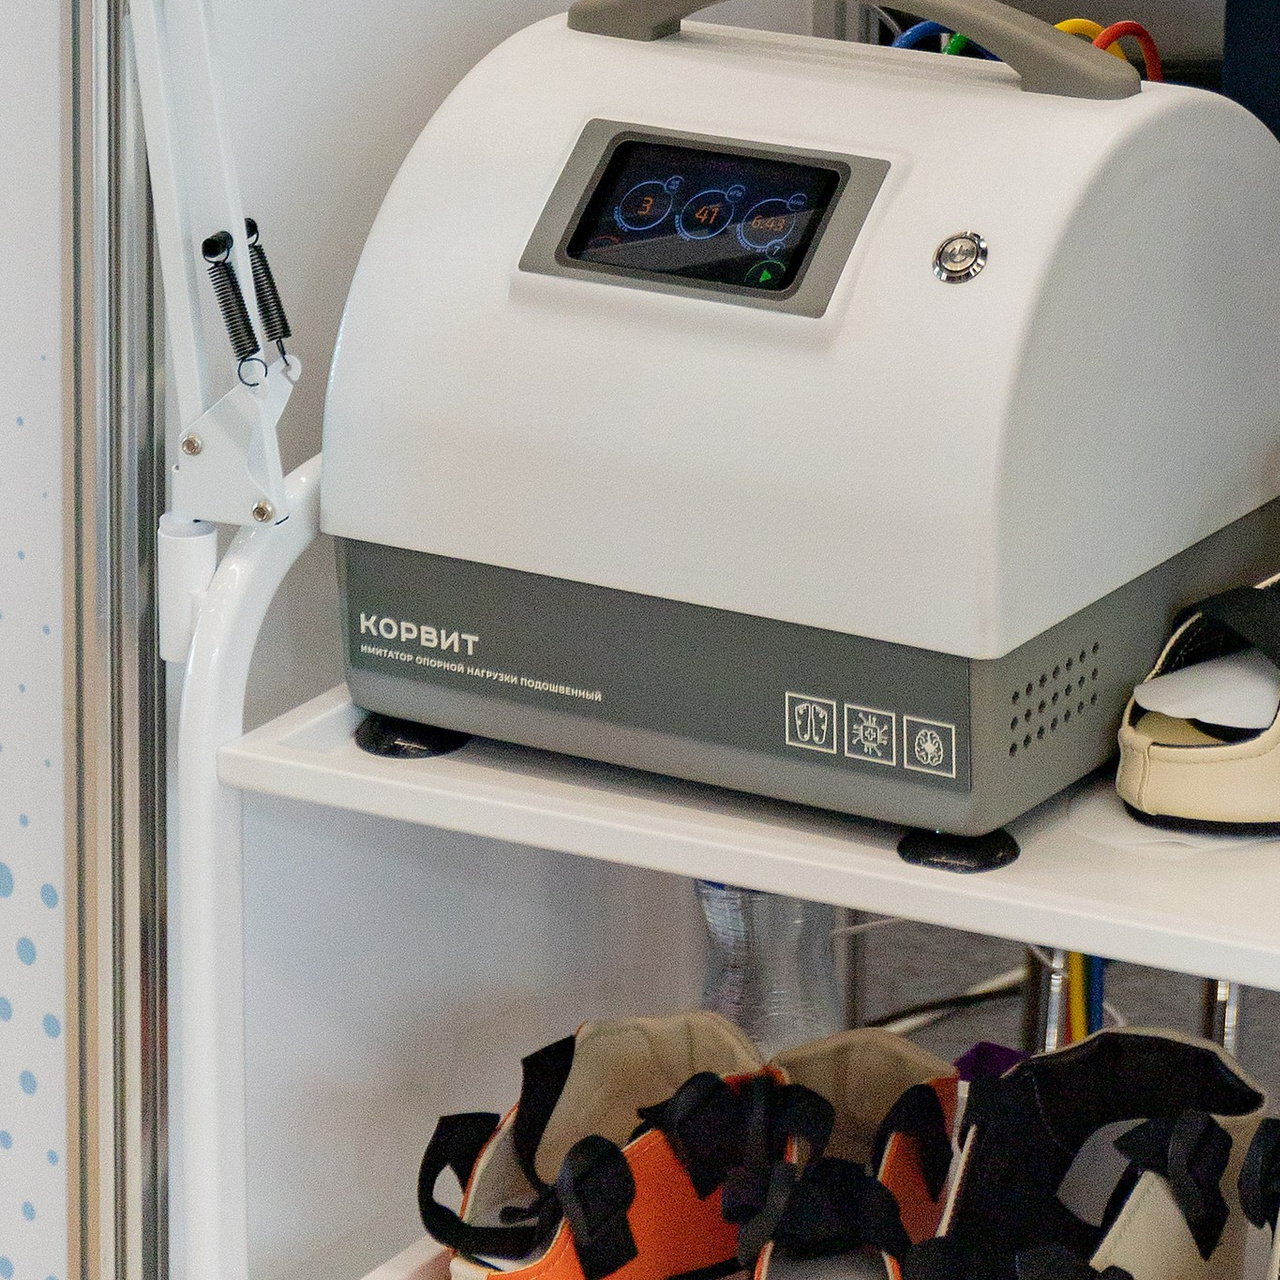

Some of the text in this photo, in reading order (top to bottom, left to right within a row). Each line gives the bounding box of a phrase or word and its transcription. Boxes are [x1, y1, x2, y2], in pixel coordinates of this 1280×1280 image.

[359, 613, 479, 656] КОРВИТ
[360, 644, 602, 702] ИМИТАТОР ОПОРНОЙ НАГРУЗКИ ПОДОШВЕННЫЙ
